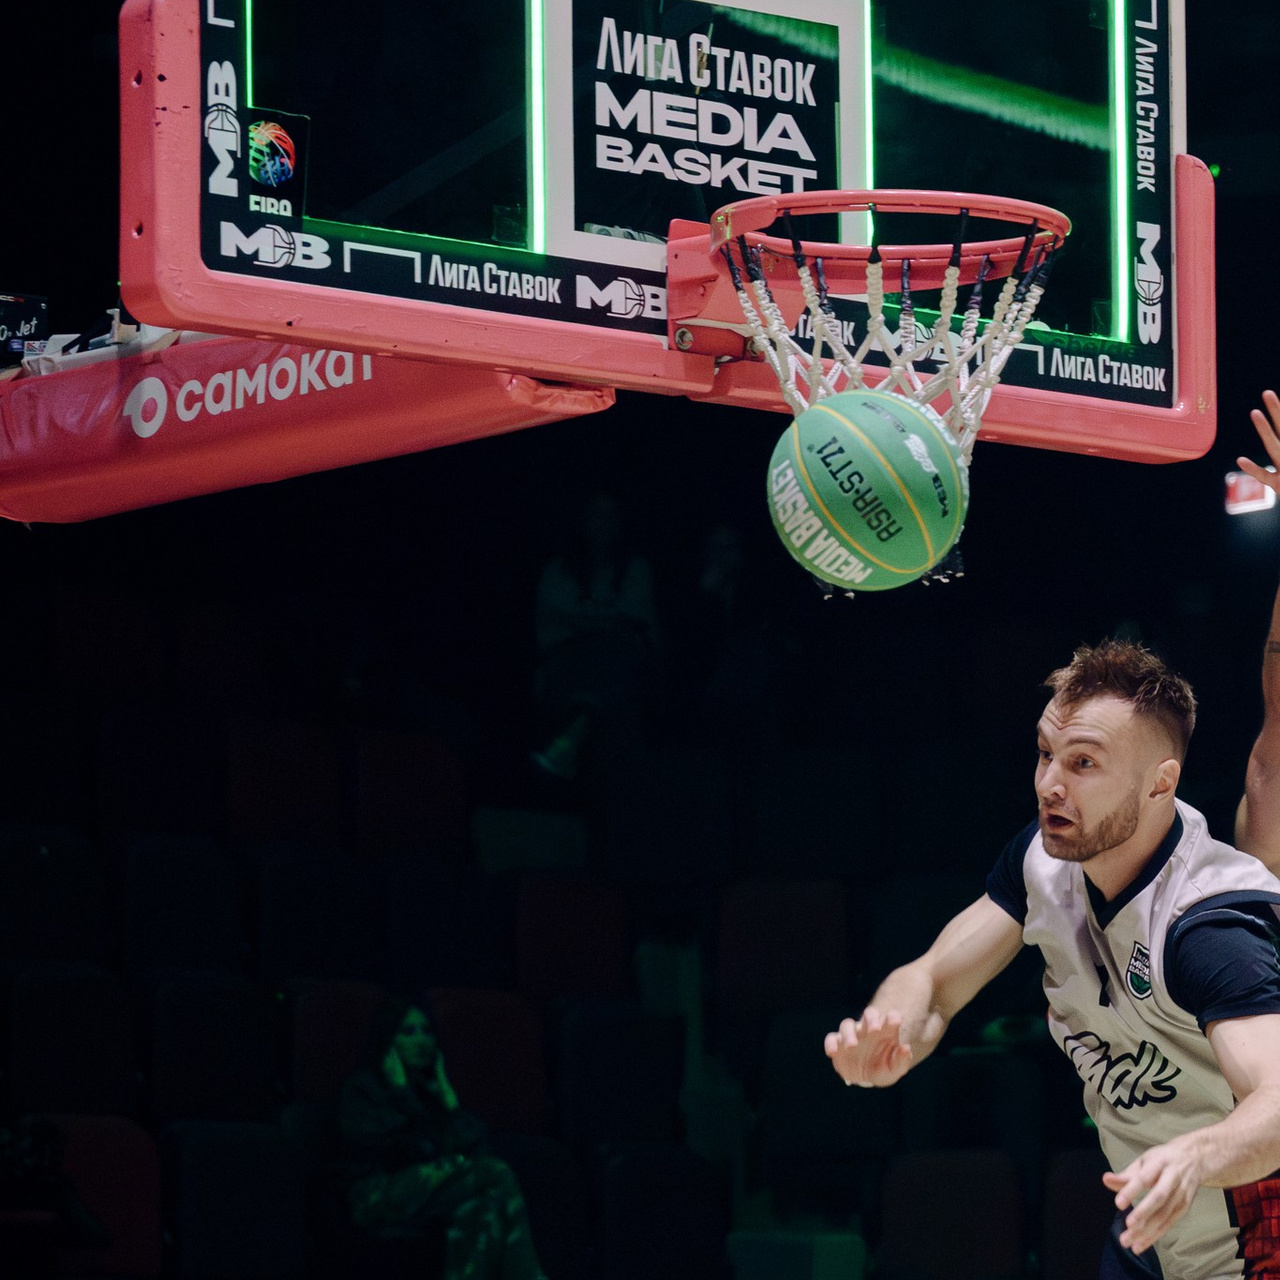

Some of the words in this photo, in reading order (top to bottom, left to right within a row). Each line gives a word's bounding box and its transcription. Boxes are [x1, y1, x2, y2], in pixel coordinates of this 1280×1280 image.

[595, 81, 817, 162] MEDIA
[596, 133, 818, 196] BASKET
[771, 458, 825, 548] BASKET
[803, 528, 874, 584] MEDIA
